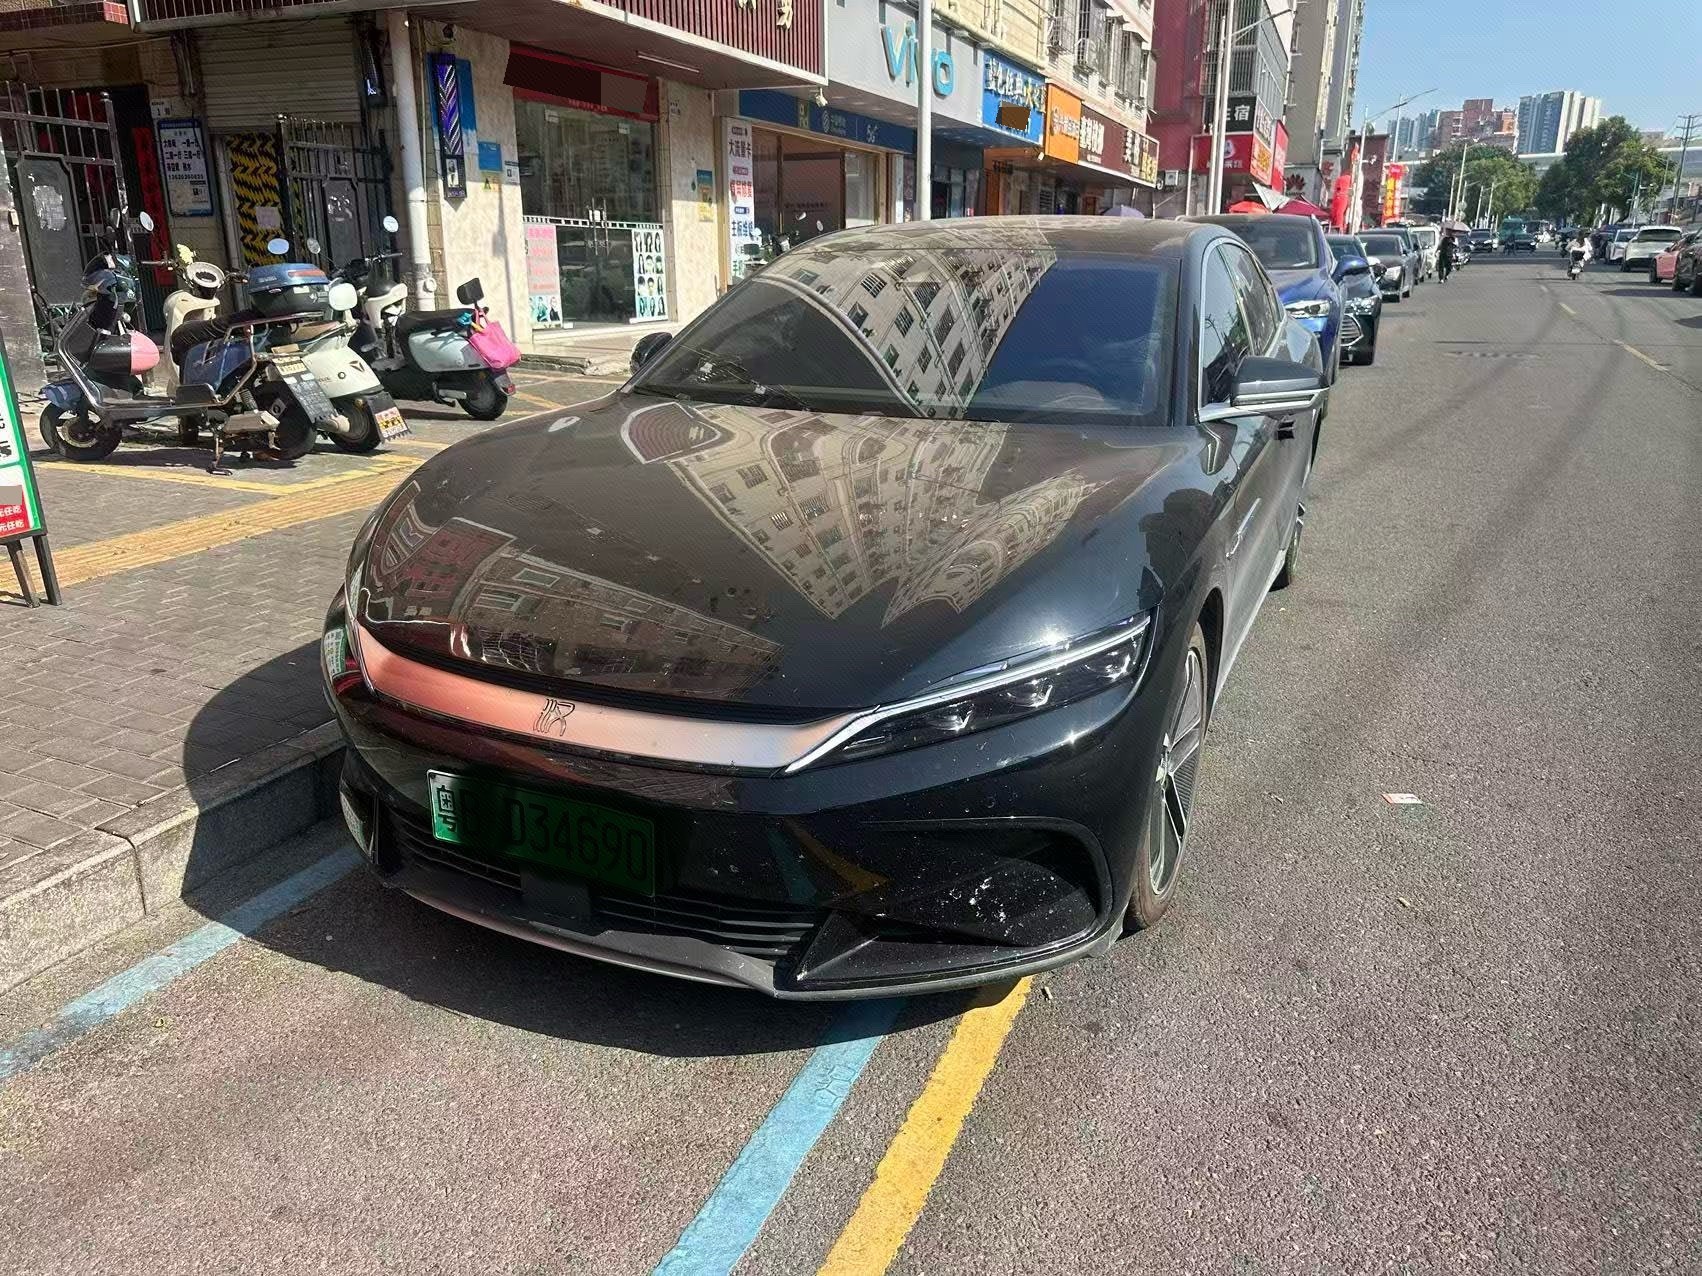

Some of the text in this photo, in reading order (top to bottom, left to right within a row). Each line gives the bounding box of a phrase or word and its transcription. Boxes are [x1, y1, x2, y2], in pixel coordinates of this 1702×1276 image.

[880, 20, 954, 98] vio
[729, 139, 752, 160] 大流量卡
